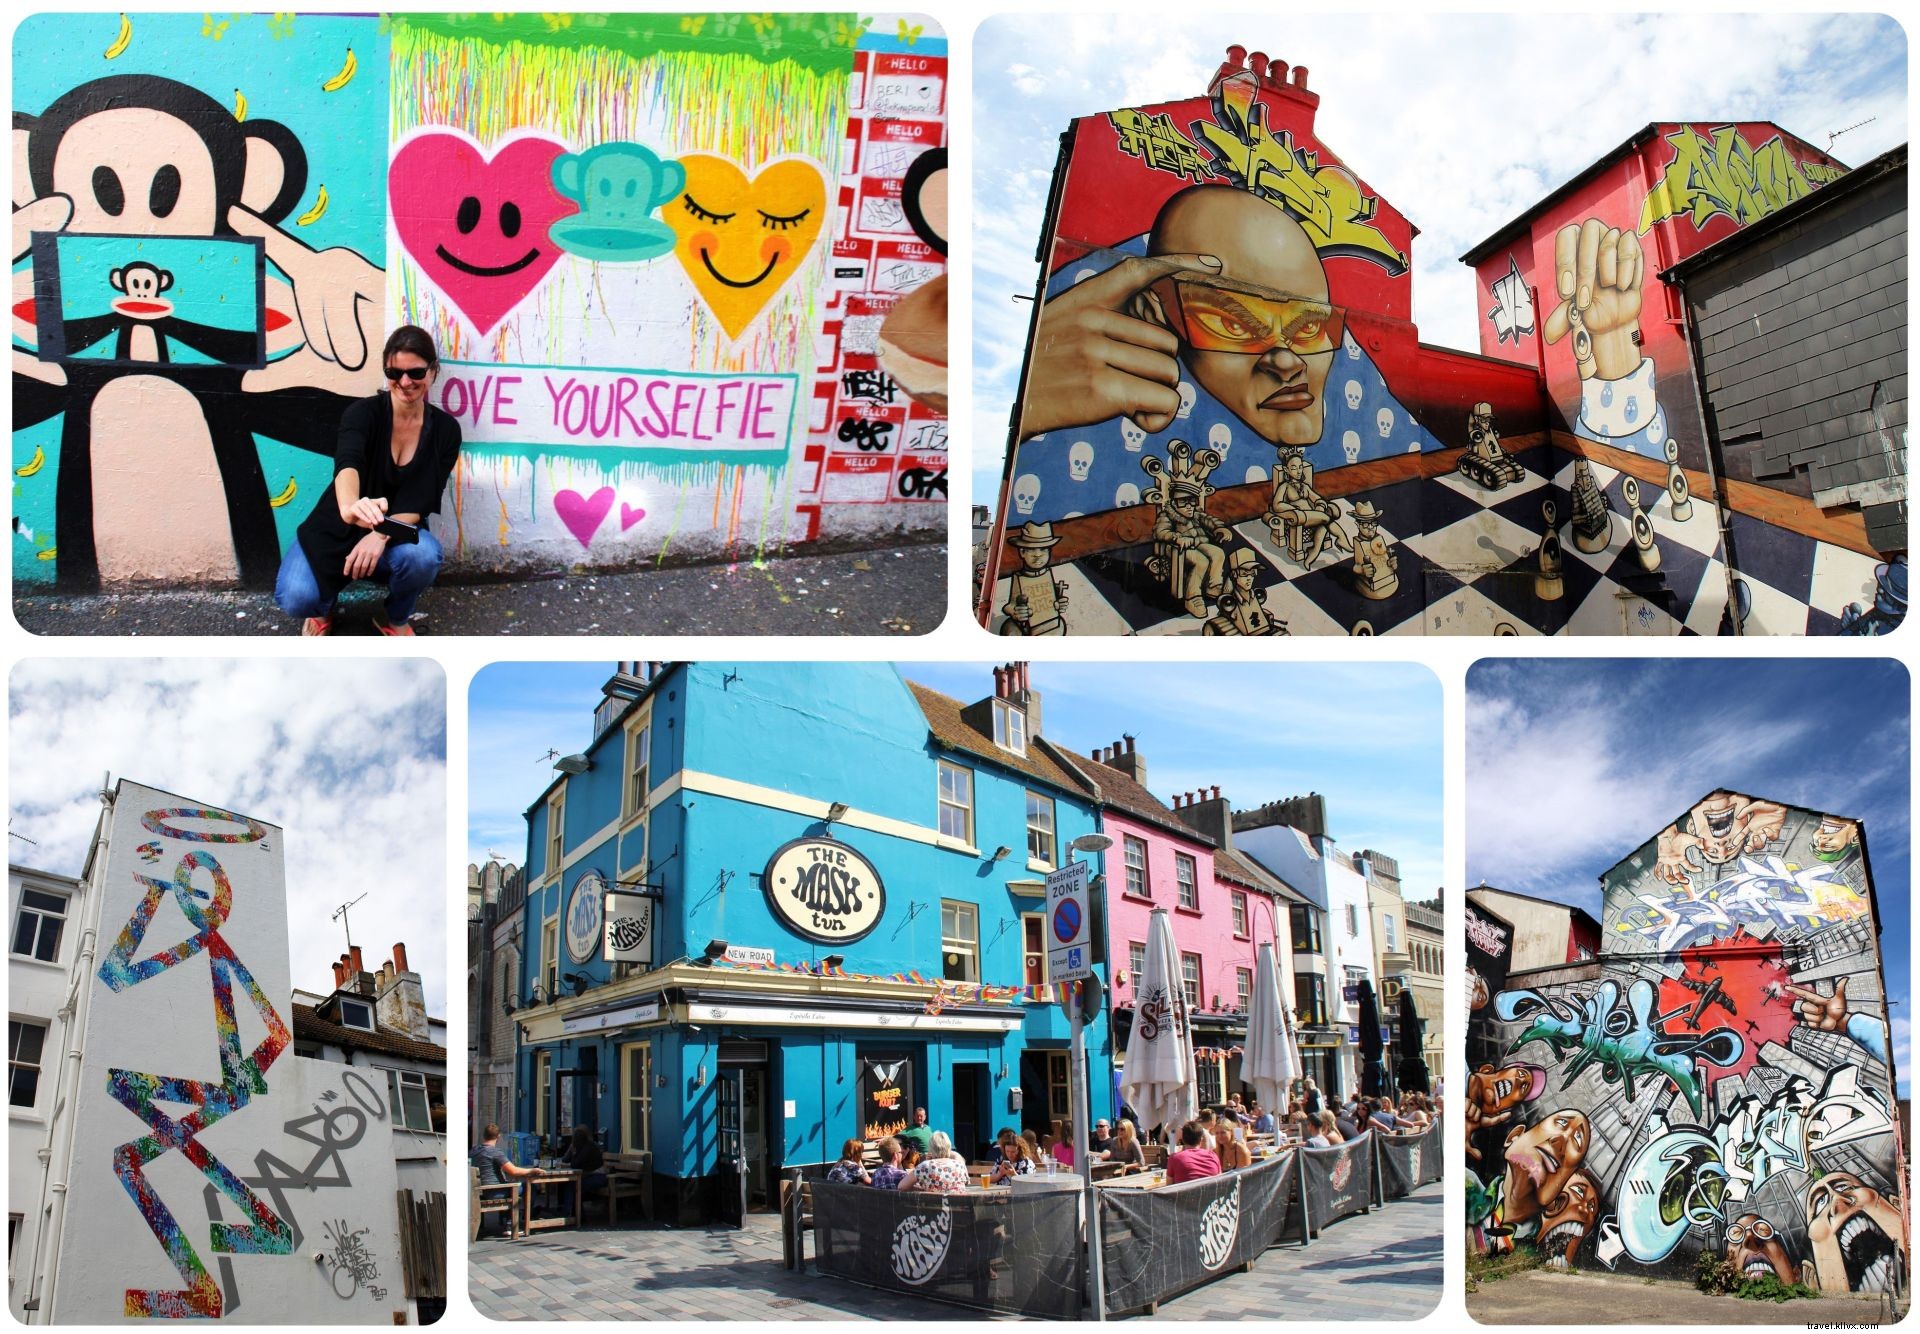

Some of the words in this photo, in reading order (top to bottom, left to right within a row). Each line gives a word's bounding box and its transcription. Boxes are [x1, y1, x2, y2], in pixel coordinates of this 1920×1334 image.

[890, 58, 927, 70] HELLO
[886, 124, 923, 137] HELLO
[881, 180, 902, 192] HEL
[832, 240, 858, 251] ELLO
[896, 243, 932, 256] HELLO
[425, 375, 522, 428] OVE
[545, 376, 784, 441] YOURSELFIE
[856, 407, 889, 418] HELLO
[844, 457, 878, 468] HELLO
[916, 455, 948, 466] HELLO
[805, 847, 848, 868] THE
[1047, 864, 1086, 886] Restricted
[791, 862, 863, 915] MASH
[1052, 879, 1080, 898] ZONE
[612, 916, 628, 927] THE
[811, 912, 847, 931] tun
[728, 949, 746, 959] NEW
[749, 951, 773, 961] ROAD
[1052, 957, 1068, 968] Except
[872, 1087, 902, 1101] BURGER
[1202, 1199, 1219, 1222] THE
[896, 1214, 919, 1235] THE
[1199, 1198, 1238, 1264] MASH
[891, 1220, 948, 1279] MASH
